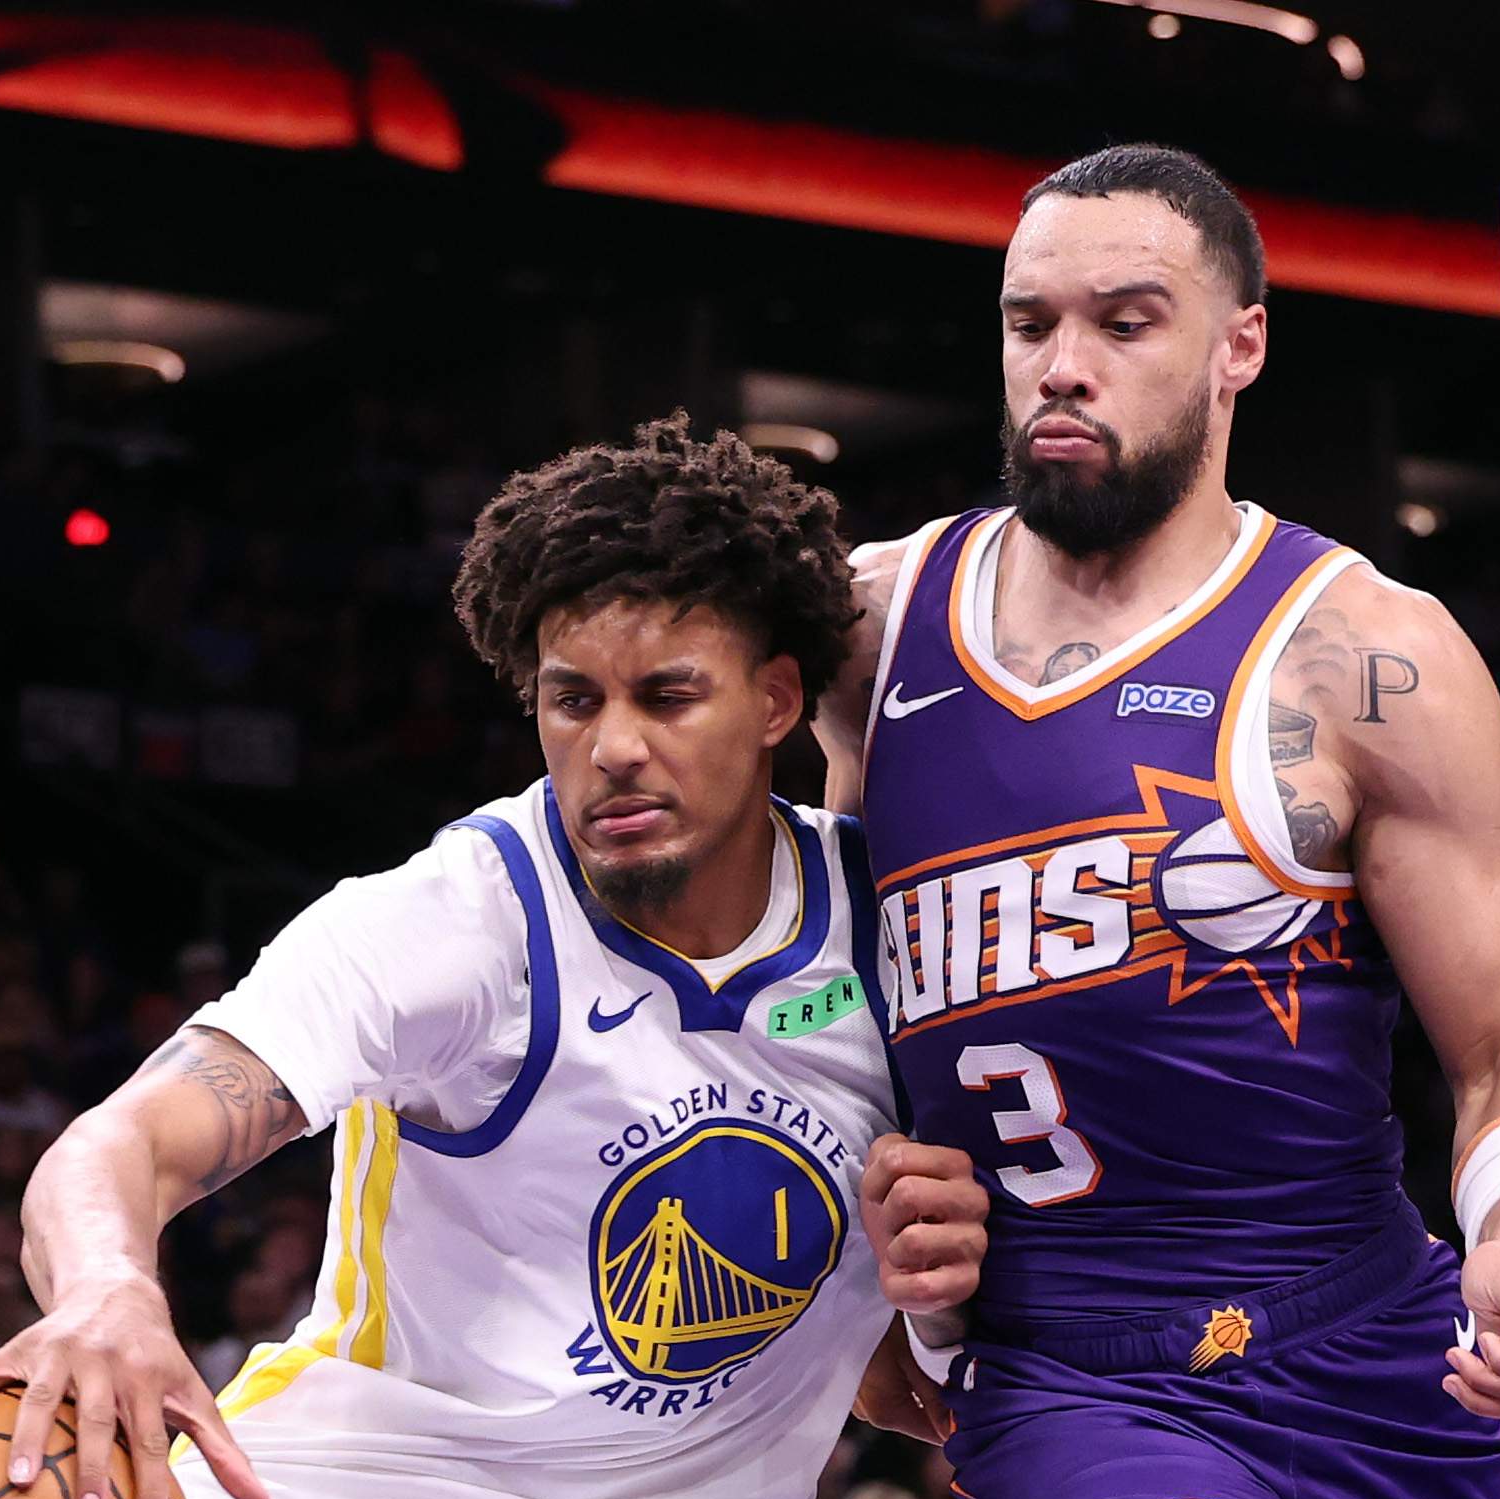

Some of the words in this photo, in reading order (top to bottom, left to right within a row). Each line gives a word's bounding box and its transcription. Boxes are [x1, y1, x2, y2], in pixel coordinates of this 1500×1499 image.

[1119, 684, 1213, 714] paze
[776, 981, 855, 1032] IREN
[598, 1083, 728, 1167] GOLDEN
[746, 1089, 849, 1168] STATE
[956, 1042, 1103, 1208] 3
[774, 1187, 788, 1261] 1
